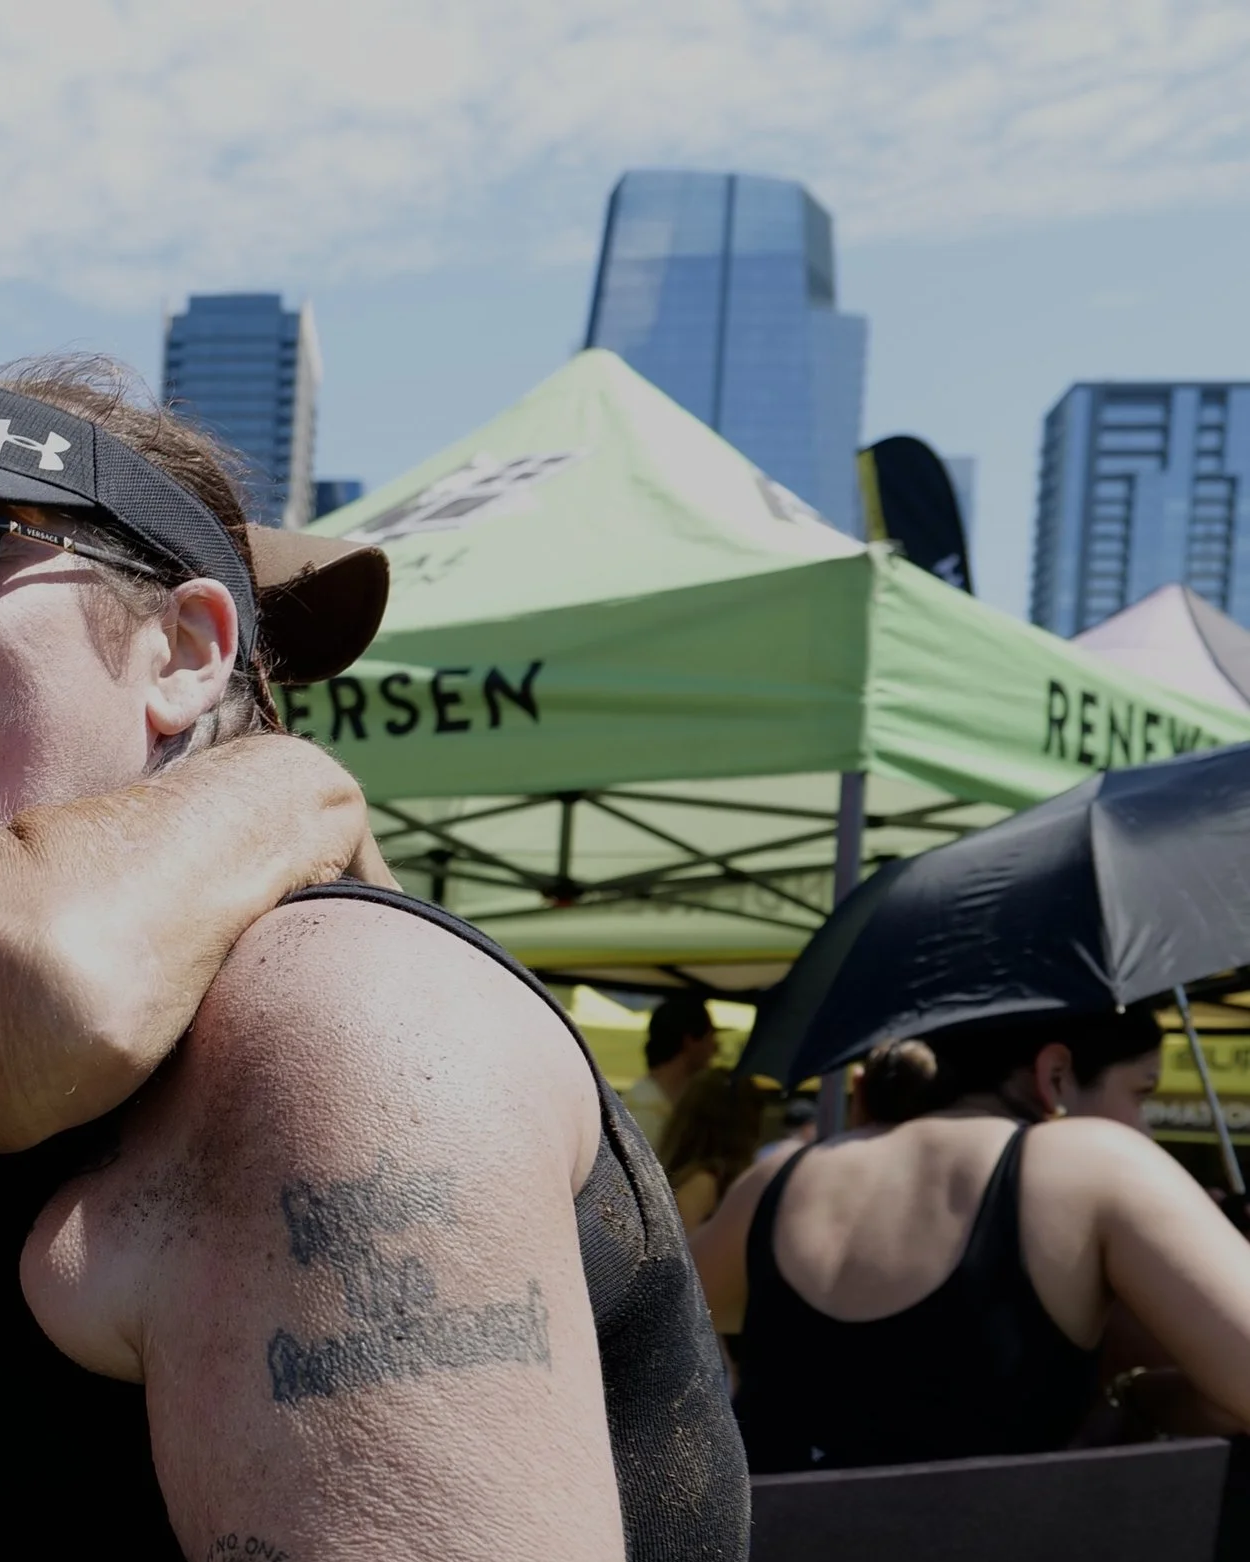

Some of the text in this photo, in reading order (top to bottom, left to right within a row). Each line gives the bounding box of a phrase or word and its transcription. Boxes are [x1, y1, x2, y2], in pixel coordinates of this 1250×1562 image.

[26, 526, 59, 544] VERSACE
[1044, 679, 1220, 771] RENEW
[216, 1533, 238, 1553] NO
